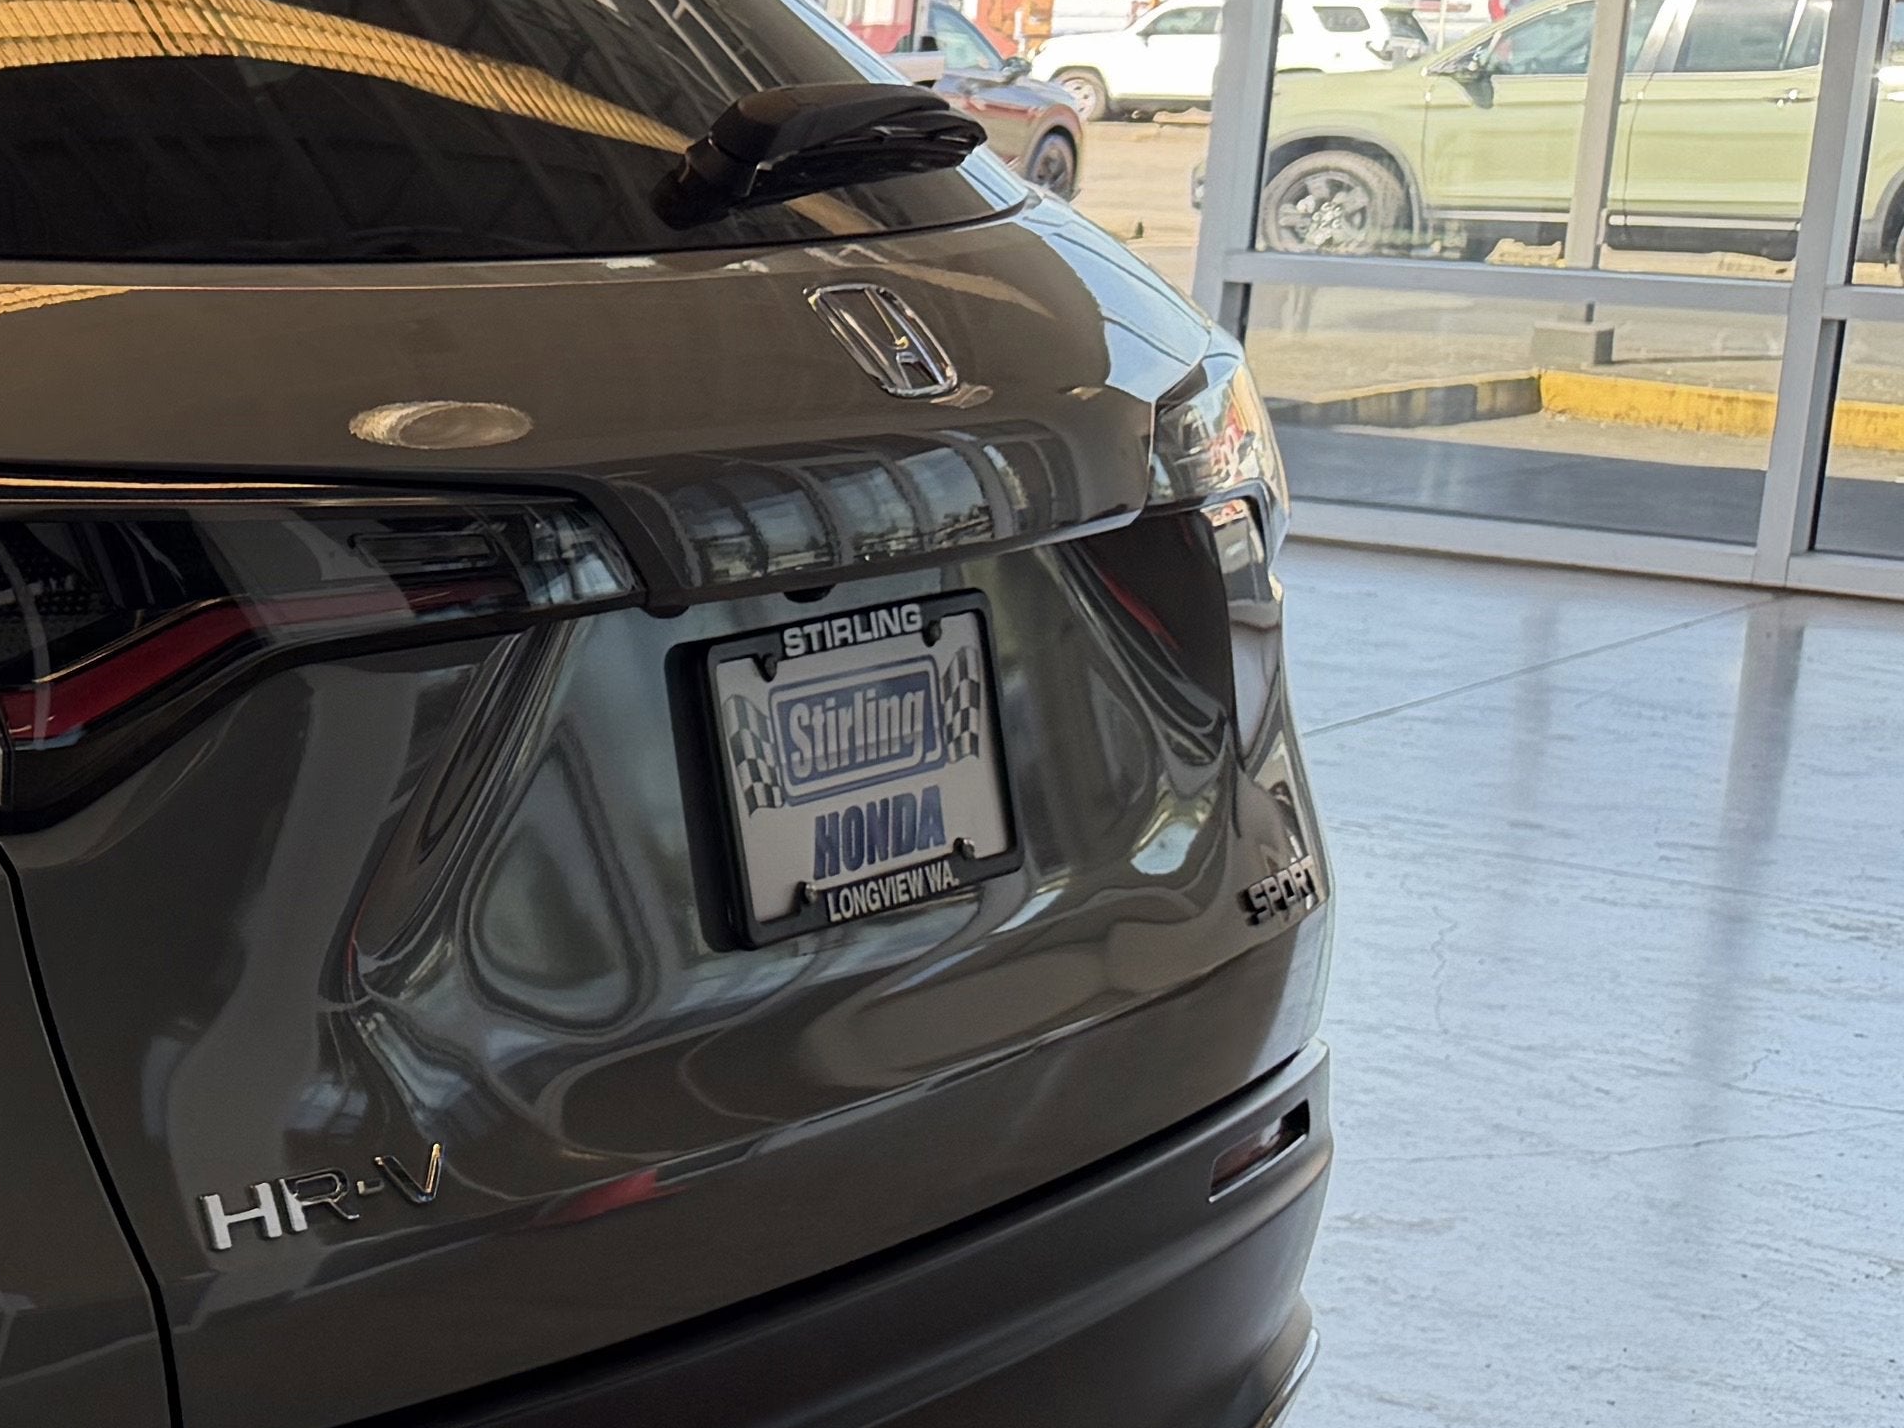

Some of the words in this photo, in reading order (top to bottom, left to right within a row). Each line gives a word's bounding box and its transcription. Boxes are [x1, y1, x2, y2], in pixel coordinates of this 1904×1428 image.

[782, 603, 923, 658] STIRLING
[790, 686, 925, 779] Stirling
[813, 784, 946, 880] HONDA
[827, 866, 925, 922] LONGVIEW
[925, 859, 960, 893] WA.
[1248, 854, 1328, 919] SPORT
[197, 1141, 446, 1250] HR-V
